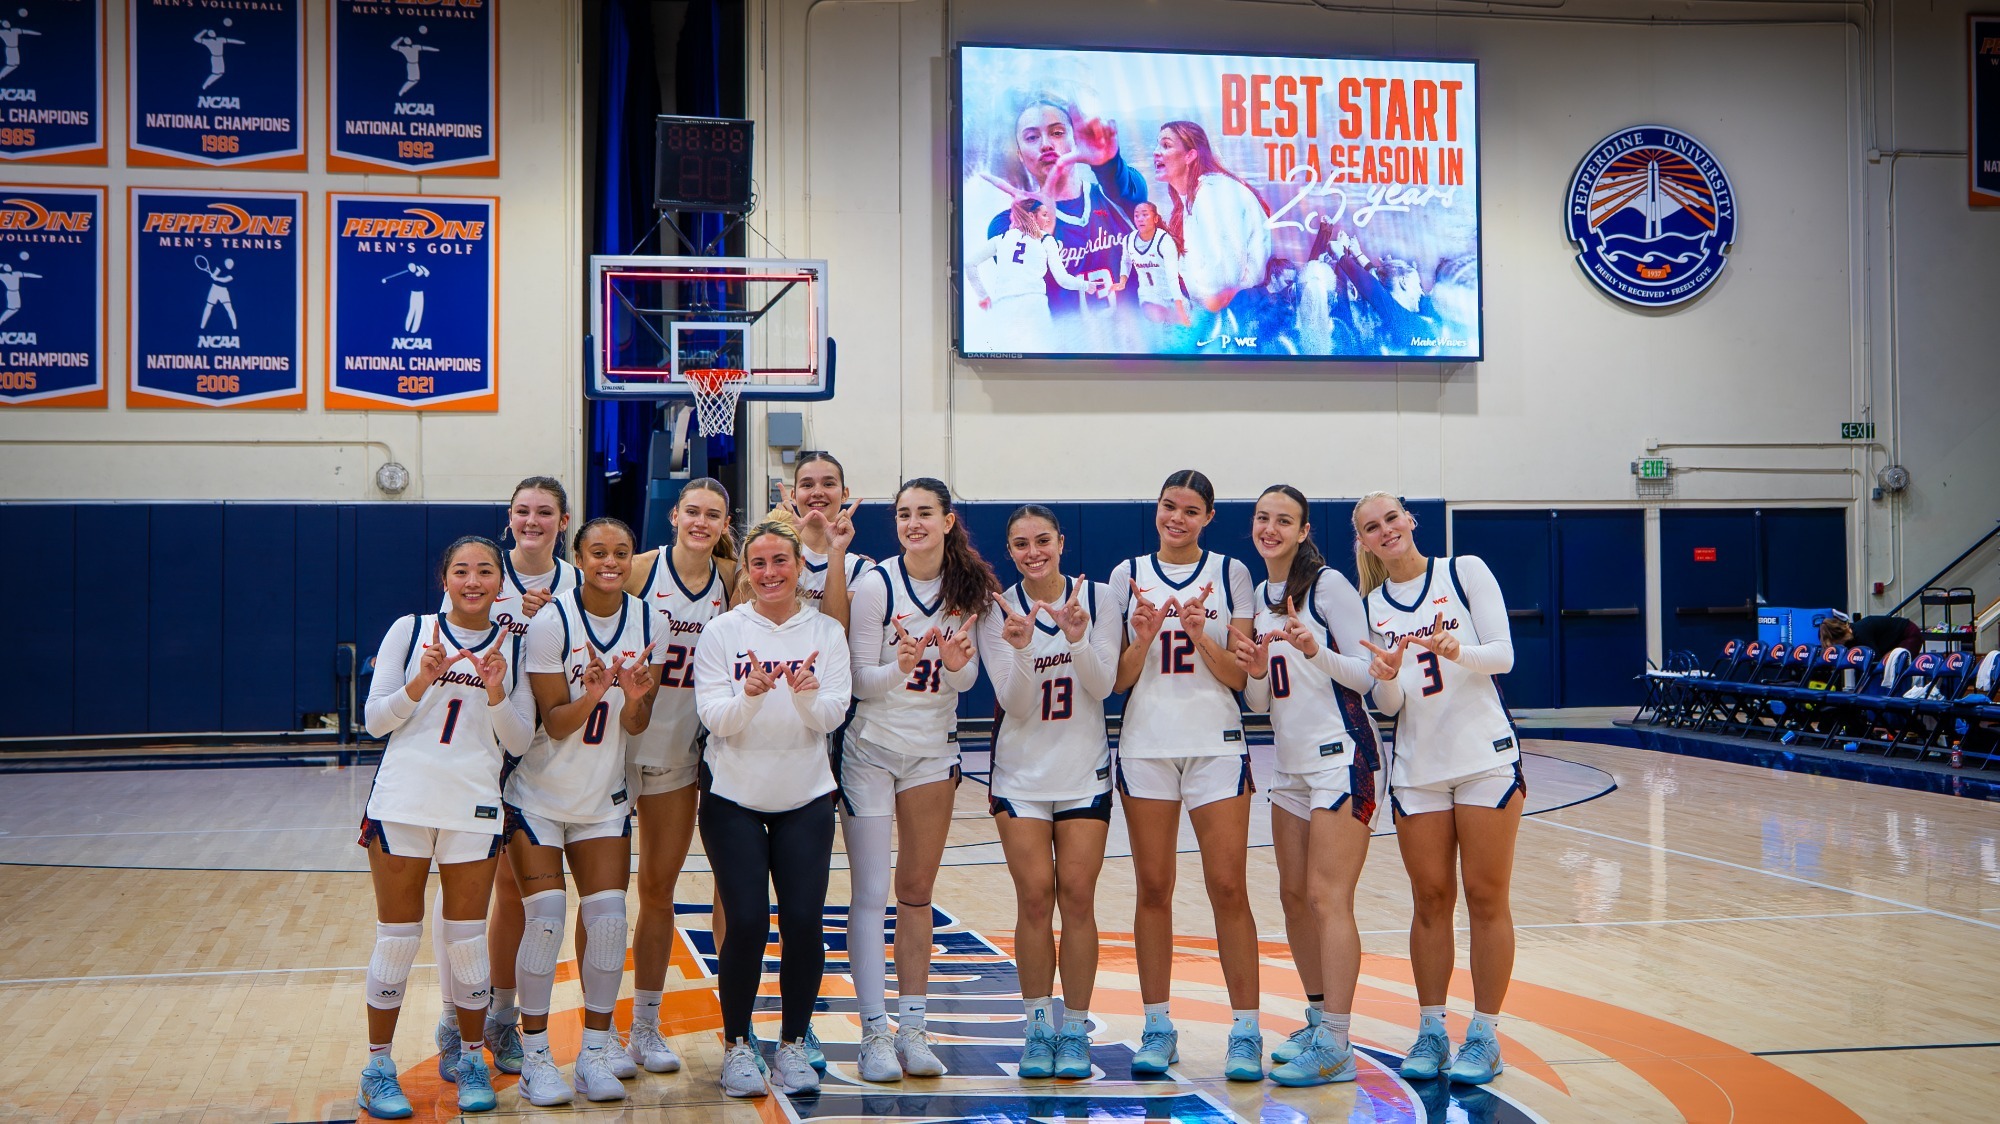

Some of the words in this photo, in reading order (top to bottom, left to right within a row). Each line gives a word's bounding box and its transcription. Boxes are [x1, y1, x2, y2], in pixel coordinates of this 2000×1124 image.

[202, 0, 283, 11] VOLLEYBALL
[352, 6, 391, 15] MEN'S
[398, 7, 476, 18] VOLLEYBALL
[197, 96, 241, 110] NCAA
[394, 102, 435, 116] NCAA
[1222, 73, 1323, 139] BEST
[1339, 77, 1463, 141] START
[9, 108, 89, 126] CHAMPIONS
[146, 113, 210, 130] NATIONAL
[214, 116, 291, 132] CHAMPIONS
[0, 128, 36, 146] 985
[345, 120, 407, 136] NATIONAL
[410, 122, 482, 139] CHAMPIONS
[201, 135, 240, 153] 1986
[398, 141, 434, 159] 1992
[1264, 143, 1296, 182] TO
[1305, 143, 1322, 183] A
[1330, 144, 1429, 185] SEASON
[1438, 147, 1464, 186] IN
[1574, 132, 1644, 216] PEPPERDINE
[1664, 133, 1732, 220] UNIVERSITY
[1263, 164, 1363, 235] 25
[1352, 183, 1457, 228] years
[142, 203, 293, 236] PEPPERDINE
[341, 208, 485, 240] PEPPERDINE
[159, 237, 213, 248] MEN'S
[222, 238, 283, 250] TENNIS
[358, 241, 416, 253] MEN'S
[427, 243, 473, 255] GOLF
[1013, 241, 1026, 264] 2
[1146, 272, 1154, 286] 1
[1595, 263, 1618, 285] FREELY
[1618, 281, 1628, 291] YE
[1628, 286, 1665, 298] RECEIVED
[1671, 279, 1696, 296] FREELY
[1696, 266, 1713, 283] GIVE
[1647, 270, 1662, 278] 1937
[197, 336, 241, 349] NCAA
[391, 337, 432, 350] NCAA
[10, 352, 89, 367] CHAMPIONS
[146, 354, 210, 370] NATIONAL
[214, 356, 290, 371] CHAMPIONS
[345, 356, 405, 371] NATIONAL
[409, 357, 481, 372] CHAMPIONS
[196, 375, 240, 393] 2006
[397, 376, 434, 394] 2021
[1644, 460, 1663, 477] EXIT
[1385, 614, 1459, 649] Pepperdne
[1160, 630, 1195, 674] 12
[906, 659, 942, 693] 31
[1270, 655, 1291, 699] 0
[1417, 650, 1444, 698] 3
[1041, 676, 1073, 721] 13
[440, 699, 463, 744] 1
[582, 701, 609, 745] 0
